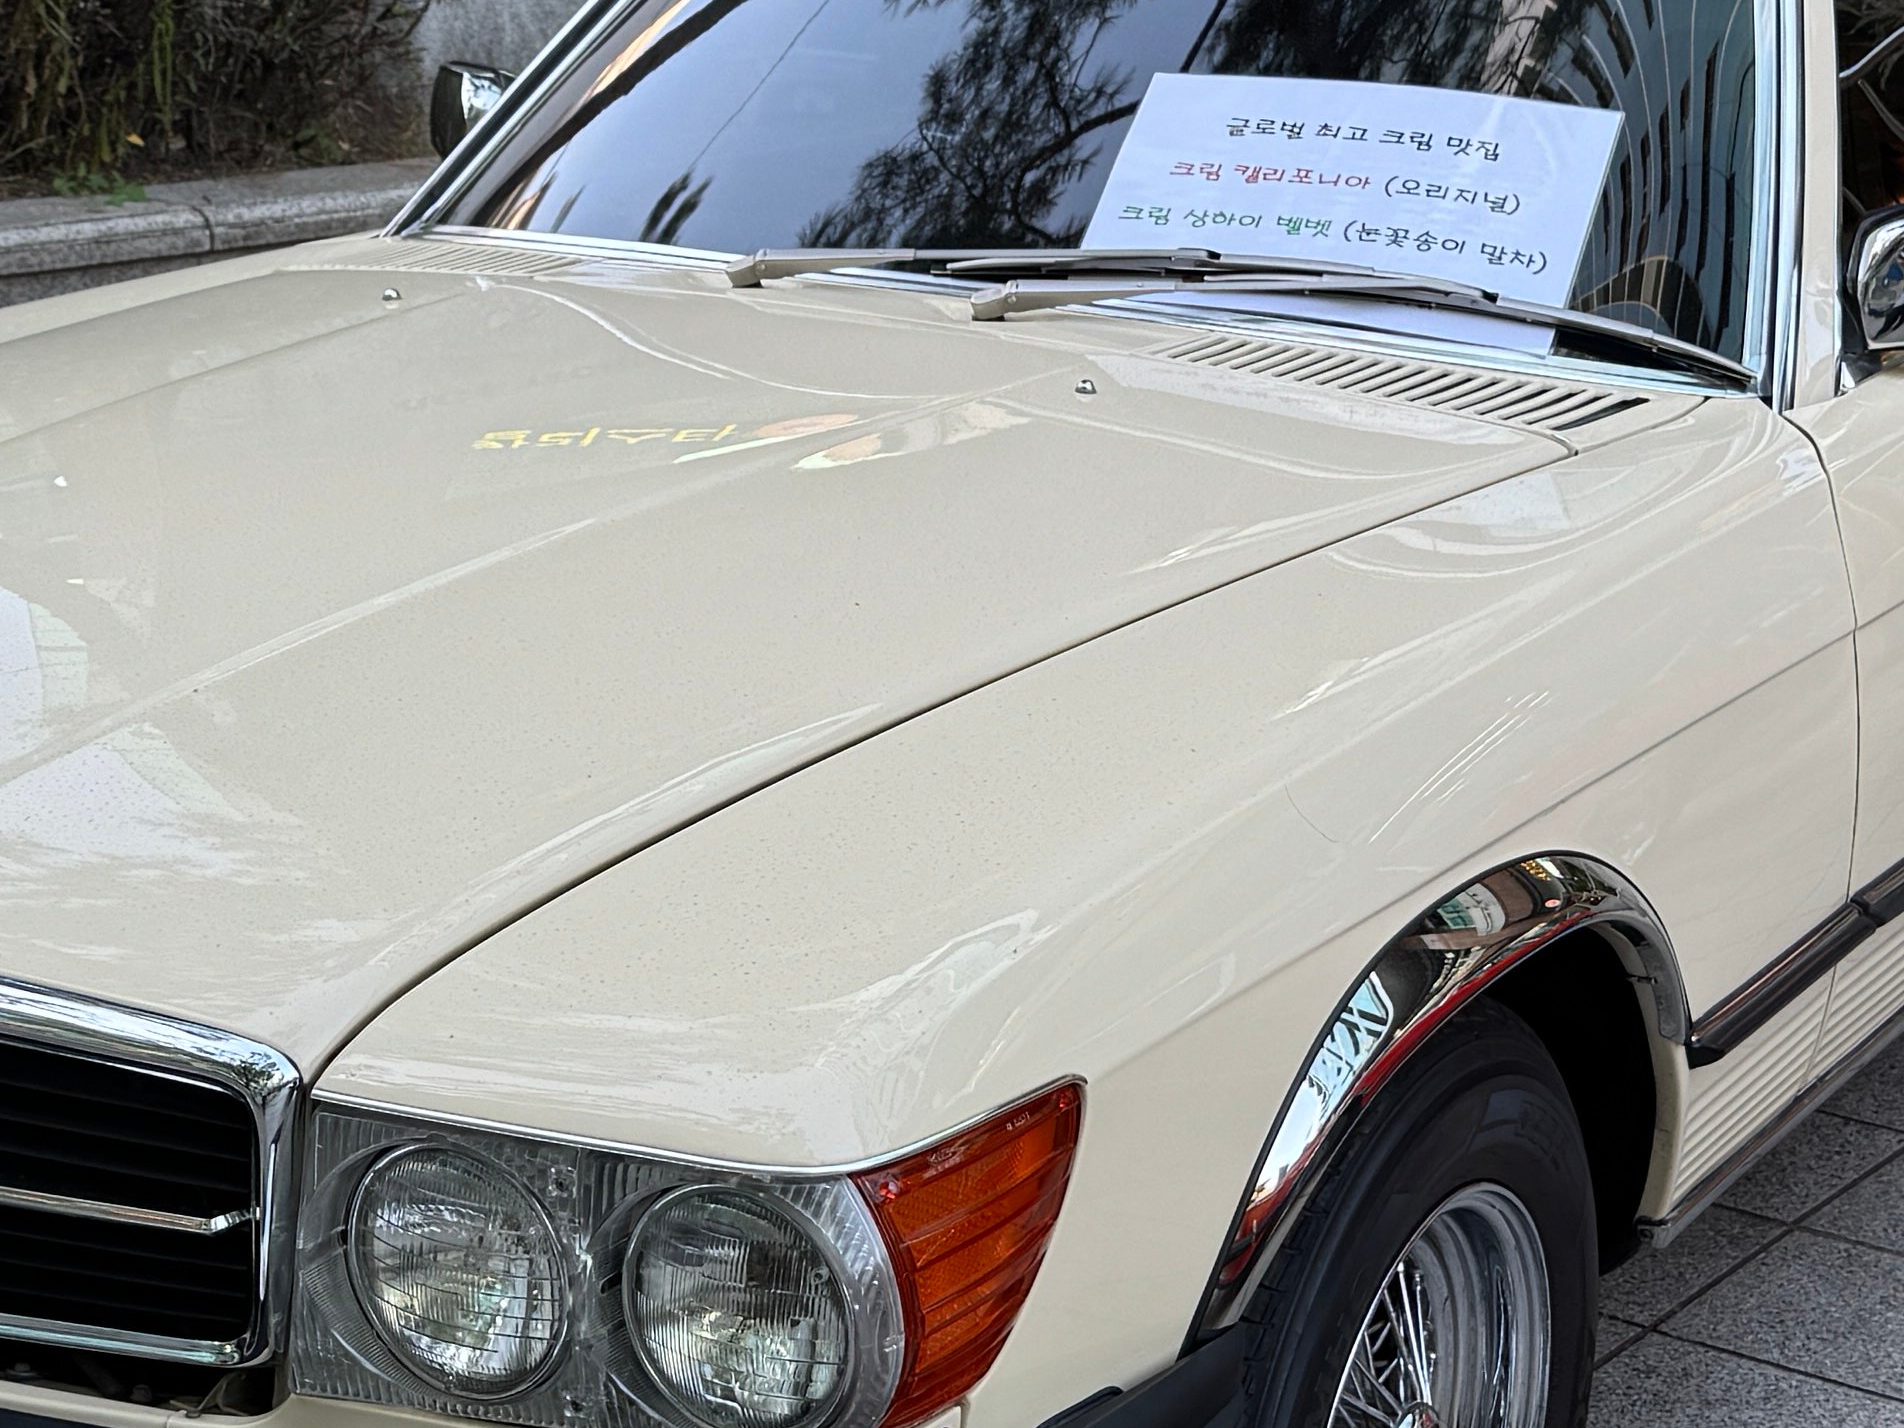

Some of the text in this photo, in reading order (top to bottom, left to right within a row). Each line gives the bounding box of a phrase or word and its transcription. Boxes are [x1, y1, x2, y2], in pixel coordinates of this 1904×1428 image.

[1226, 117, 1500, 162] 글로벌 최고 크림 맛집
[1169, 161, 1521, 216] 크림 캘리포니아 (오리지널)
[1118, 206, 1548, 275] 크림 상하이 벨벳 (눈꽃송이 말차)
